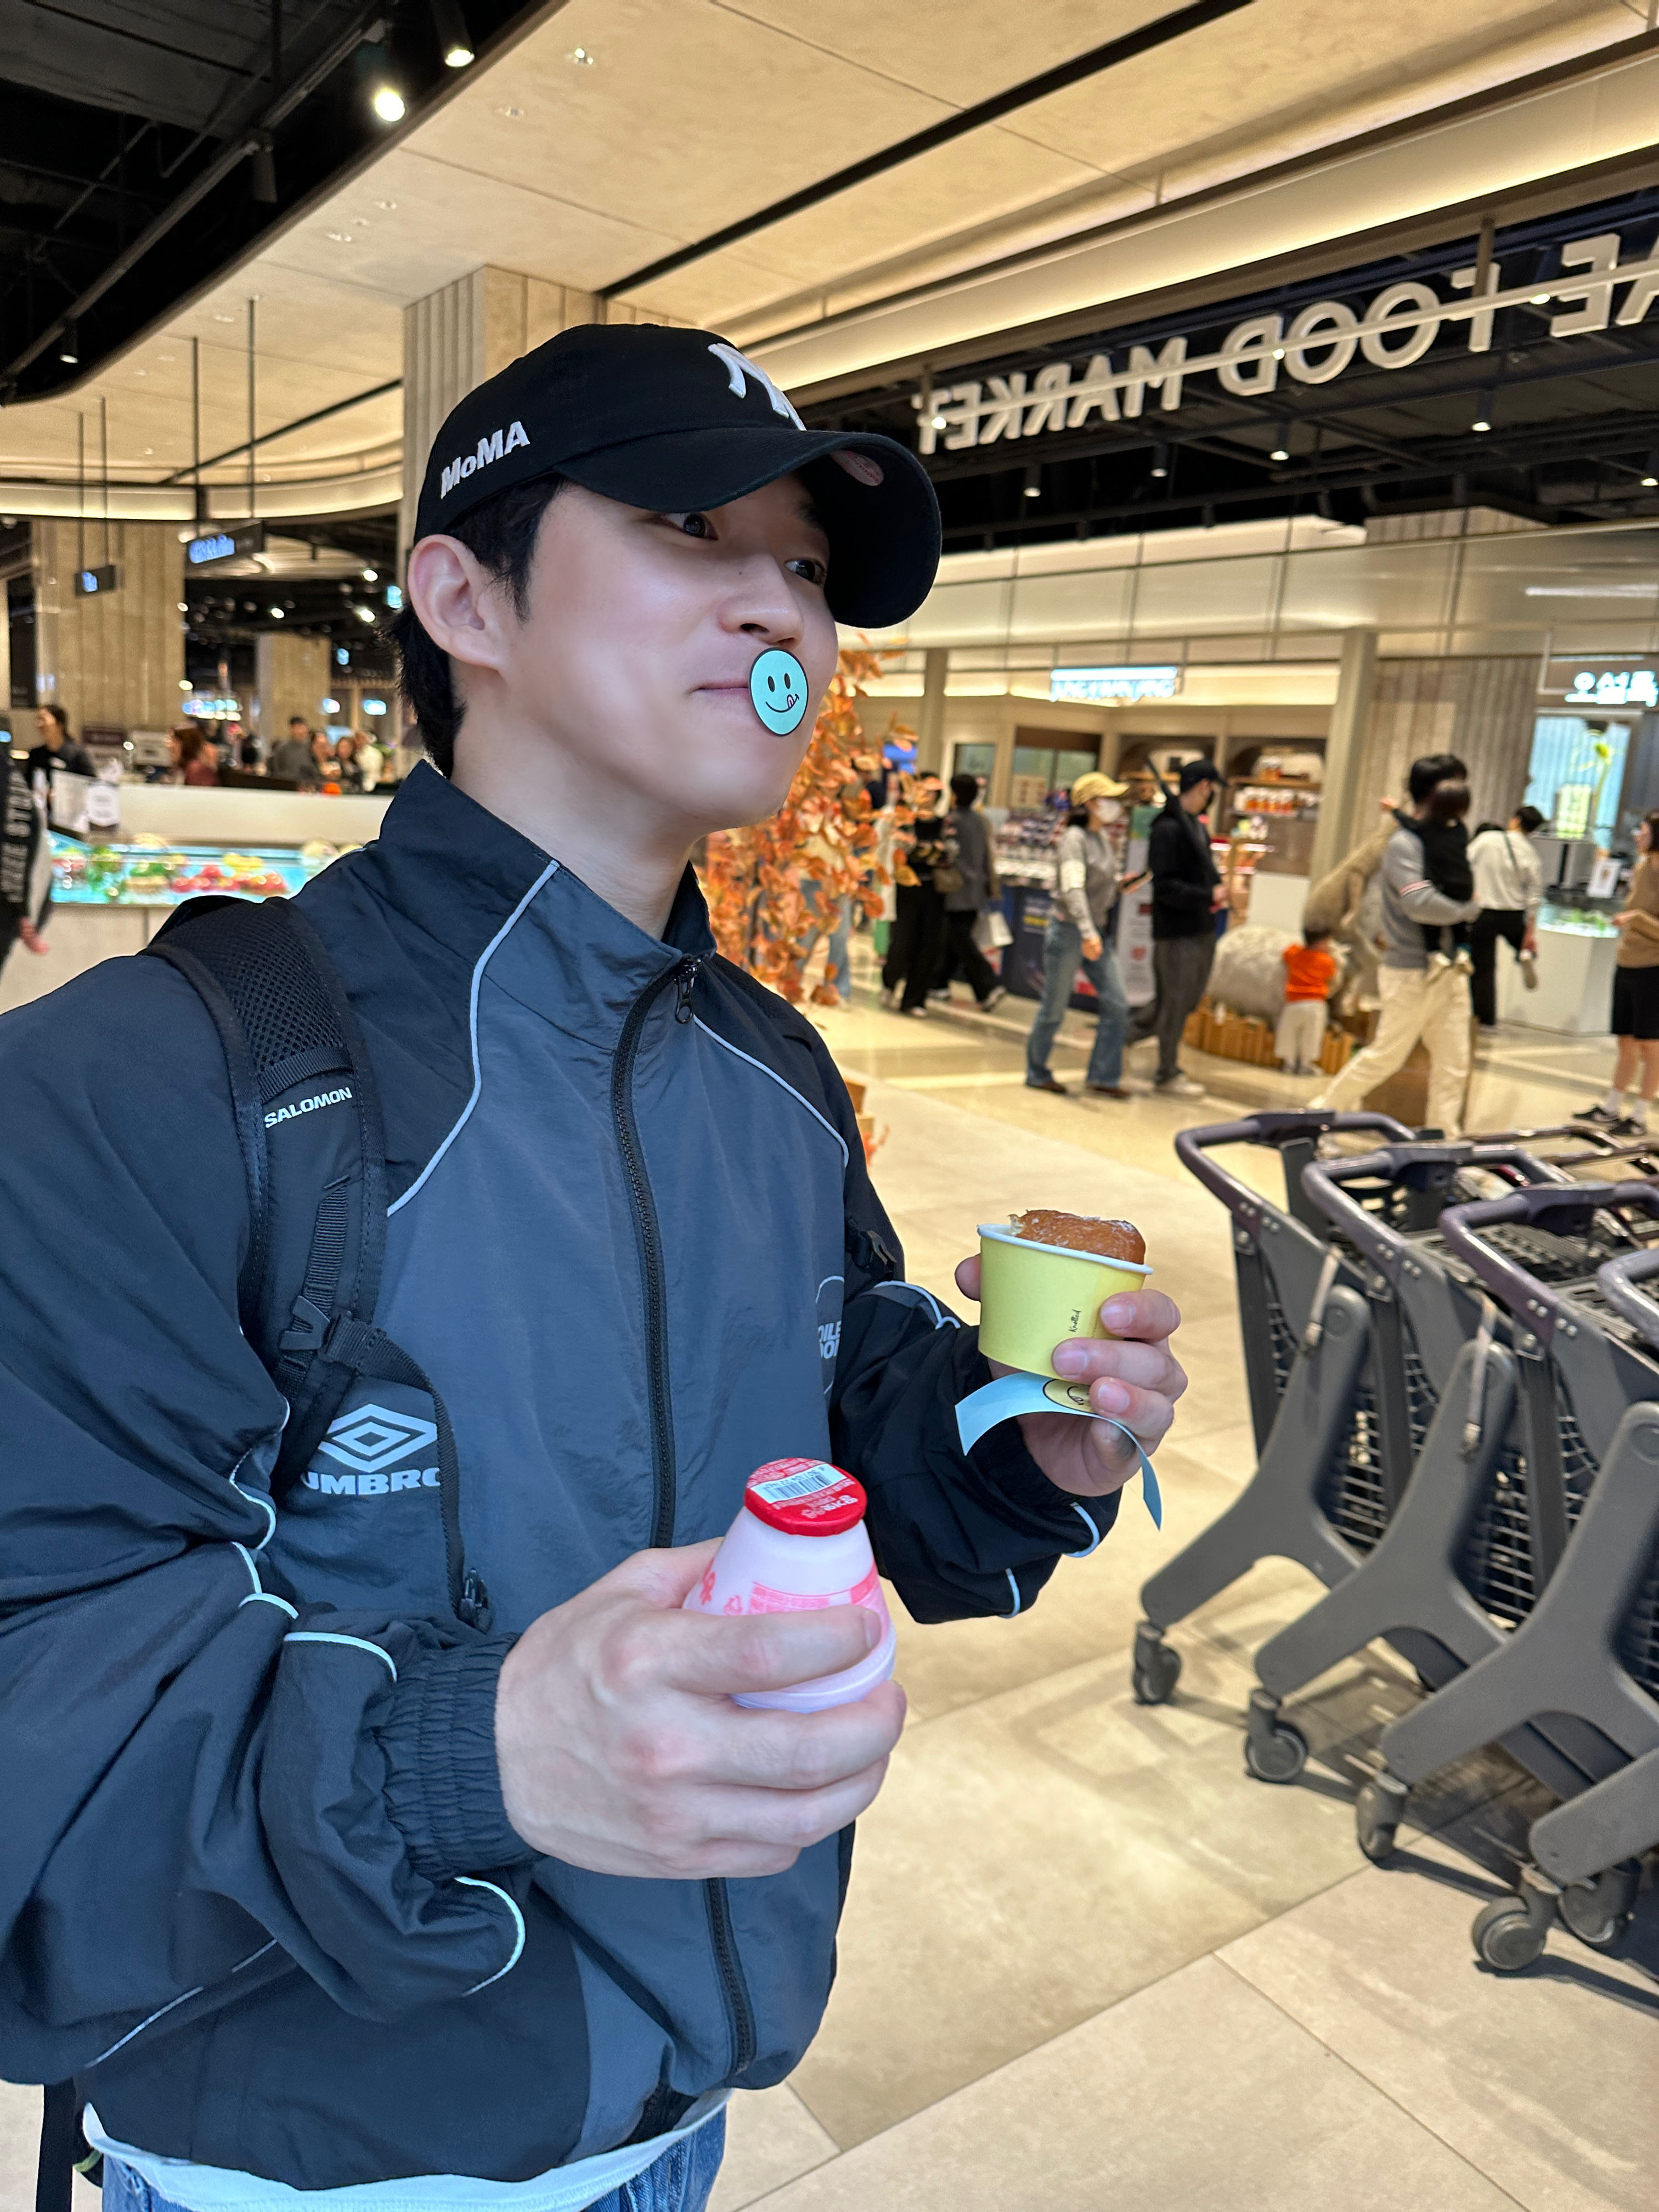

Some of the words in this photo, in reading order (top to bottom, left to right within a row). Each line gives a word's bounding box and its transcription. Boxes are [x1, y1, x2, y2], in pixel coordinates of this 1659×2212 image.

[441, 421, 531, 500] MoMA
[264, 1087, 353, 1128] SALOMON
[1068, 1308, 1081, 1333] Knotted
